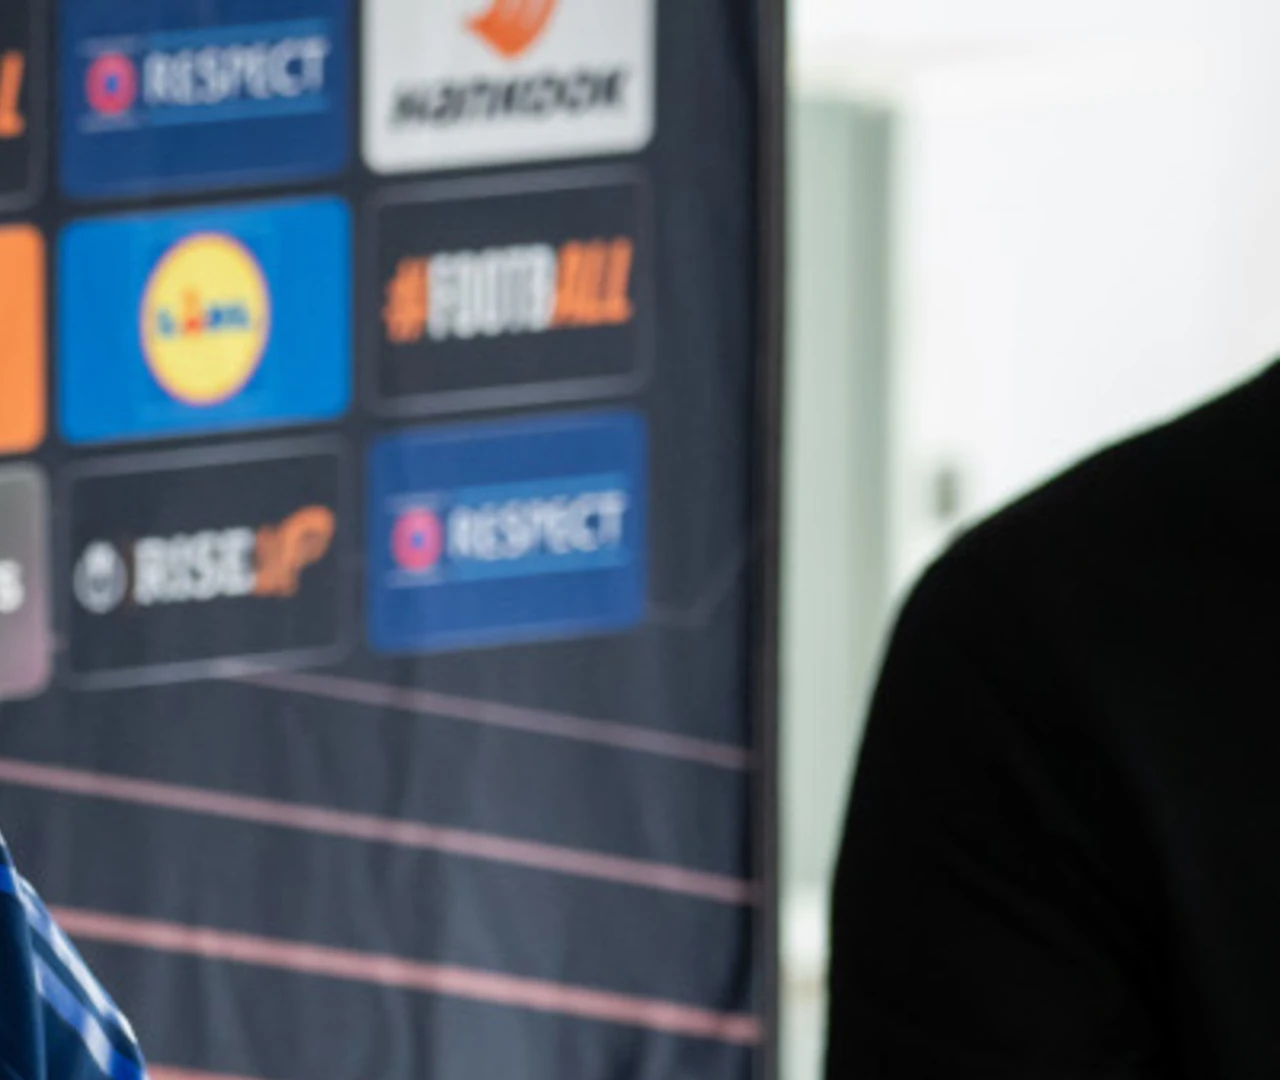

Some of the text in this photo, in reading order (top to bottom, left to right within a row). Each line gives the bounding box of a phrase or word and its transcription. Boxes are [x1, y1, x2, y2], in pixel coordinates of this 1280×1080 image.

[142, 34, 331, 104] RESPECT
[383, 238, 633, 343] #FOOTBALL
[446, 489, 628, 562] RESPECT
